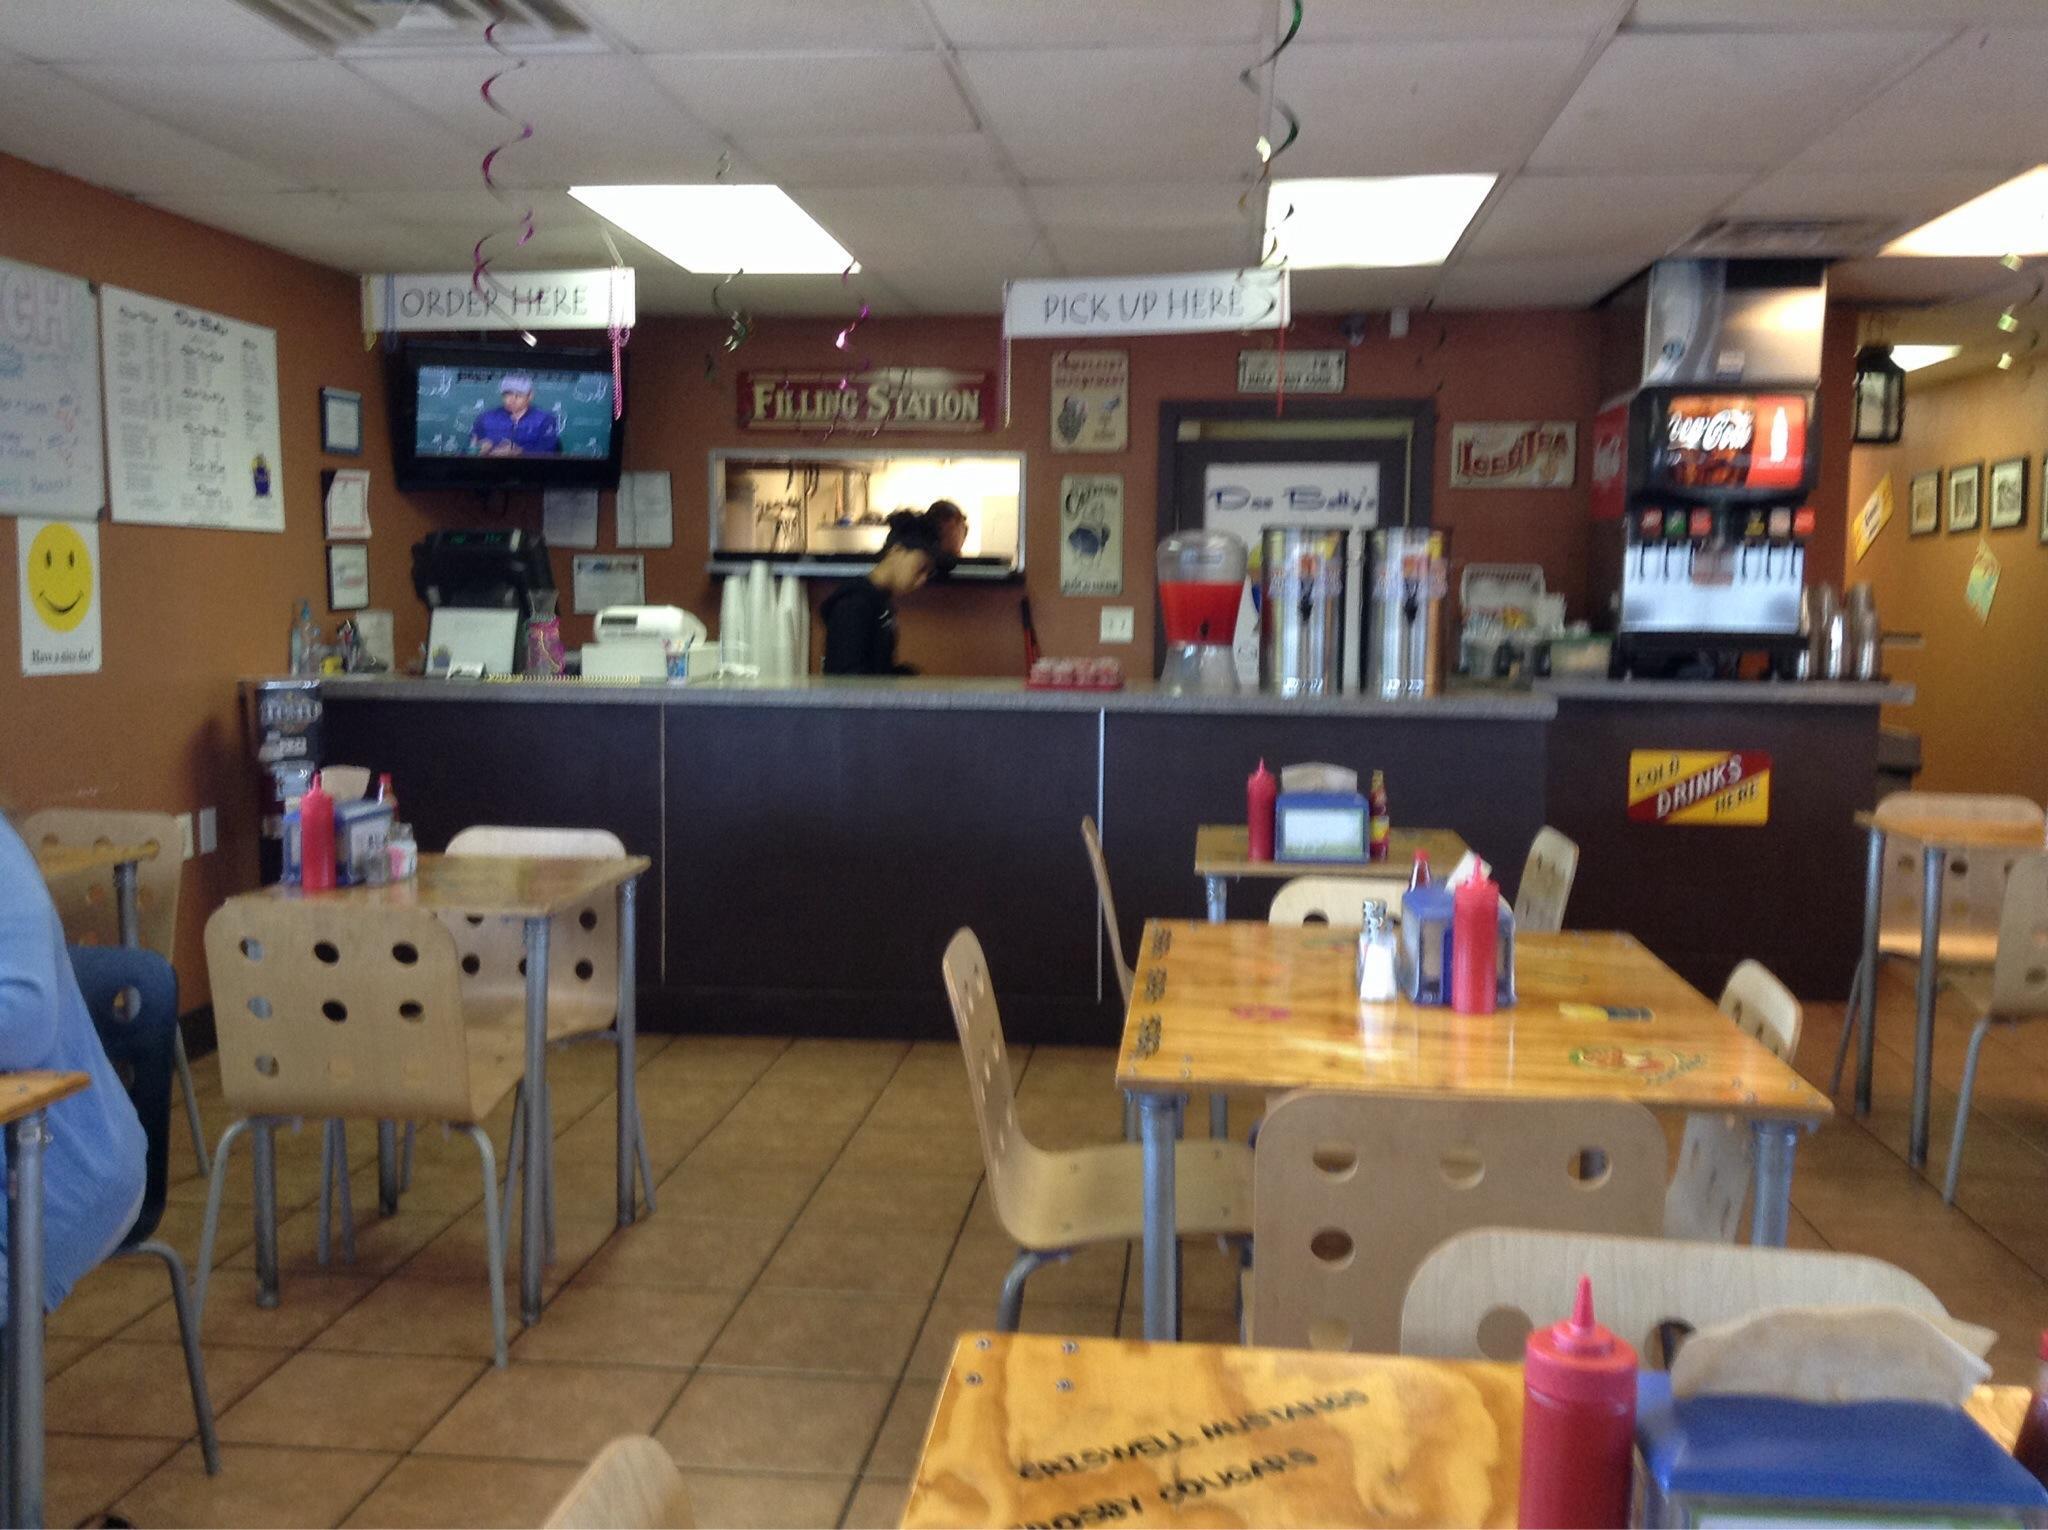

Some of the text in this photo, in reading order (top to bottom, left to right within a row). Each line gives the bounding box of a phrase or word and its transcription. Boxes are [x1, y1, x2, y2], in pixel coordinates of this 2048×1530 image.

[402, 286, 588, 319] ORDER HERE
[1044, 286, 1245, 324] PICK UP HERE
[753, 383, 981, 421] FILLING STATION
[1656, 754, 1743, 819] DRINKS
[1201, 1390, 1369, 1441] MUSTANGS
[1160, 1448, 1317, 1504] COUGARS
